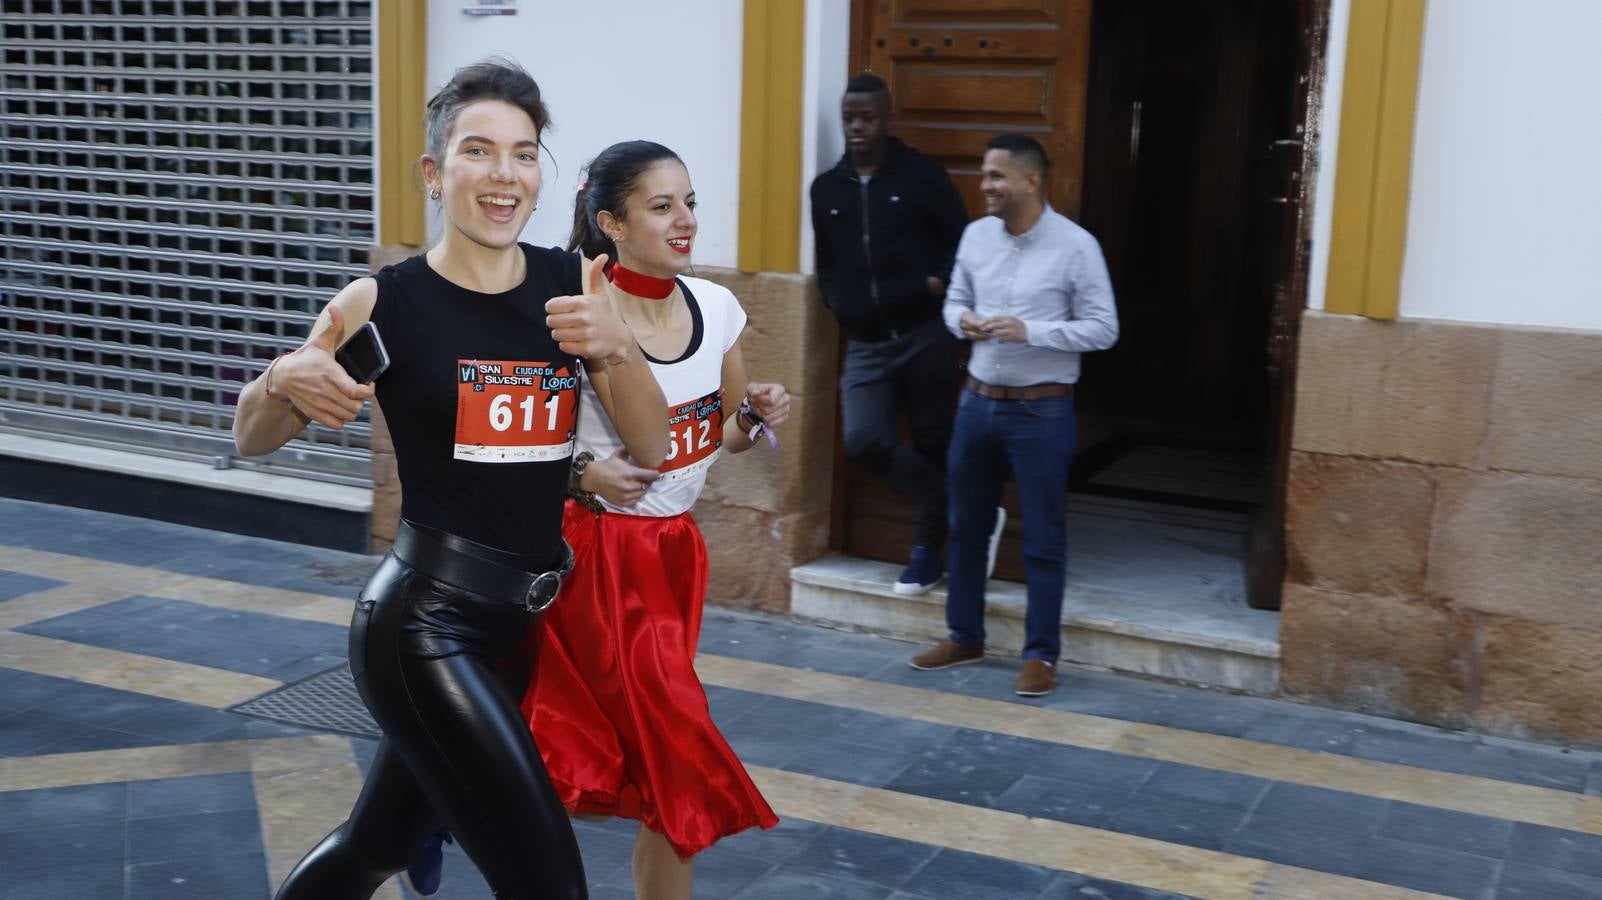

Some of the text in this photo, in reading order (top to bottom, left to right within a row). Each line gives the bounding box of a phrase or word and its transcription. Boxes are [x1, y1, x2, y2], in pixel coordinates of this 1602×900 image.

[461, 367, 475, 381] VI
[479, 364, 501, 374] SAN
[515, 366, 555, 375] CIUDAD DE
[484, 375, 533, 385] SILVESTRE
[488, 393, 560, 432] 611
